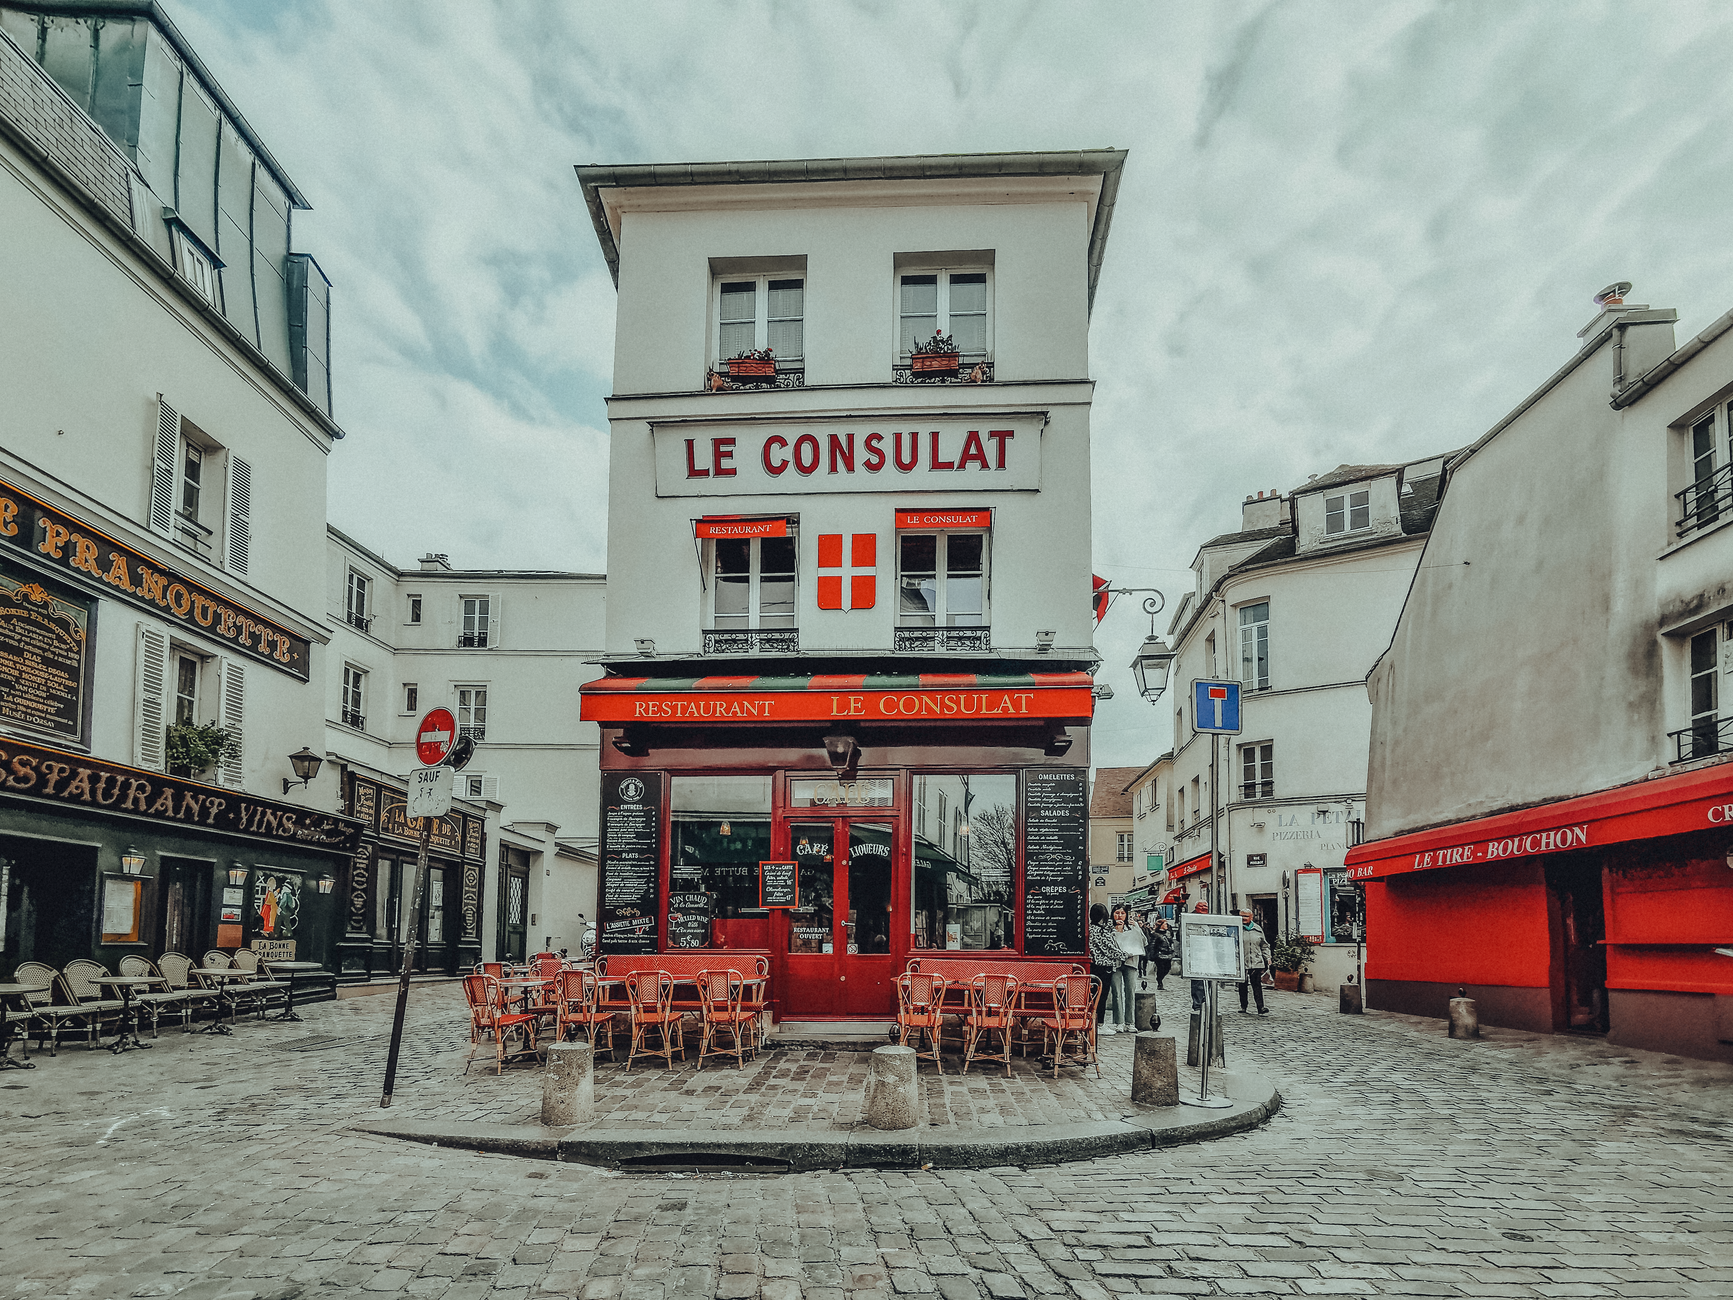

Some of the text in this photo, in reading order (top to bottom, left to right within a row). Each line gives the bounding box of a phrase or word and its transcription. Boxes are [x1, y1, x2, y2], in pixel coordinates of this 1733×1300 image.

[685, 429, 1015, 479] LE CONSULAT
[906, 513, 979, 525] LE CONSULAT
[708, 523, 773, 536] RESTAURANT
[37, 516, 292, 663] FRANQUETTE
[23, 650, 42, 663] DIAZ
[634, 693, 1035, 717] RESTAURANT LE CONSULAT
[418, 770, 441, 784] SAUF
[1038, 773, 1075, 781] OMELETTES
[0, 749, 227, 824] STAURANT
[239, 802, 297, 837] VINS
[394, 809, 405, 823] LA
[442, 822, 452, 836] DE
[1278, 813, 1300, 828] LA
[1272, 830, 1322, 841] PIZZERIA
[849, 843, 890, 858] LIQUEURS
[1413, 852, 1433, 869] LE
[1436, 845, 1474, 866] TIRE
[1486, 825, 1588, 860] BOUCHON
[1356, 865, 1374, 878] BAR
[1041, 885, 1067, 893] CRÊPES
[670, 894, 708, 904] VIN CHAUD
[632, 917, 650, 926] MIXTE
[258, 940, 290, 951] LA BONNE
